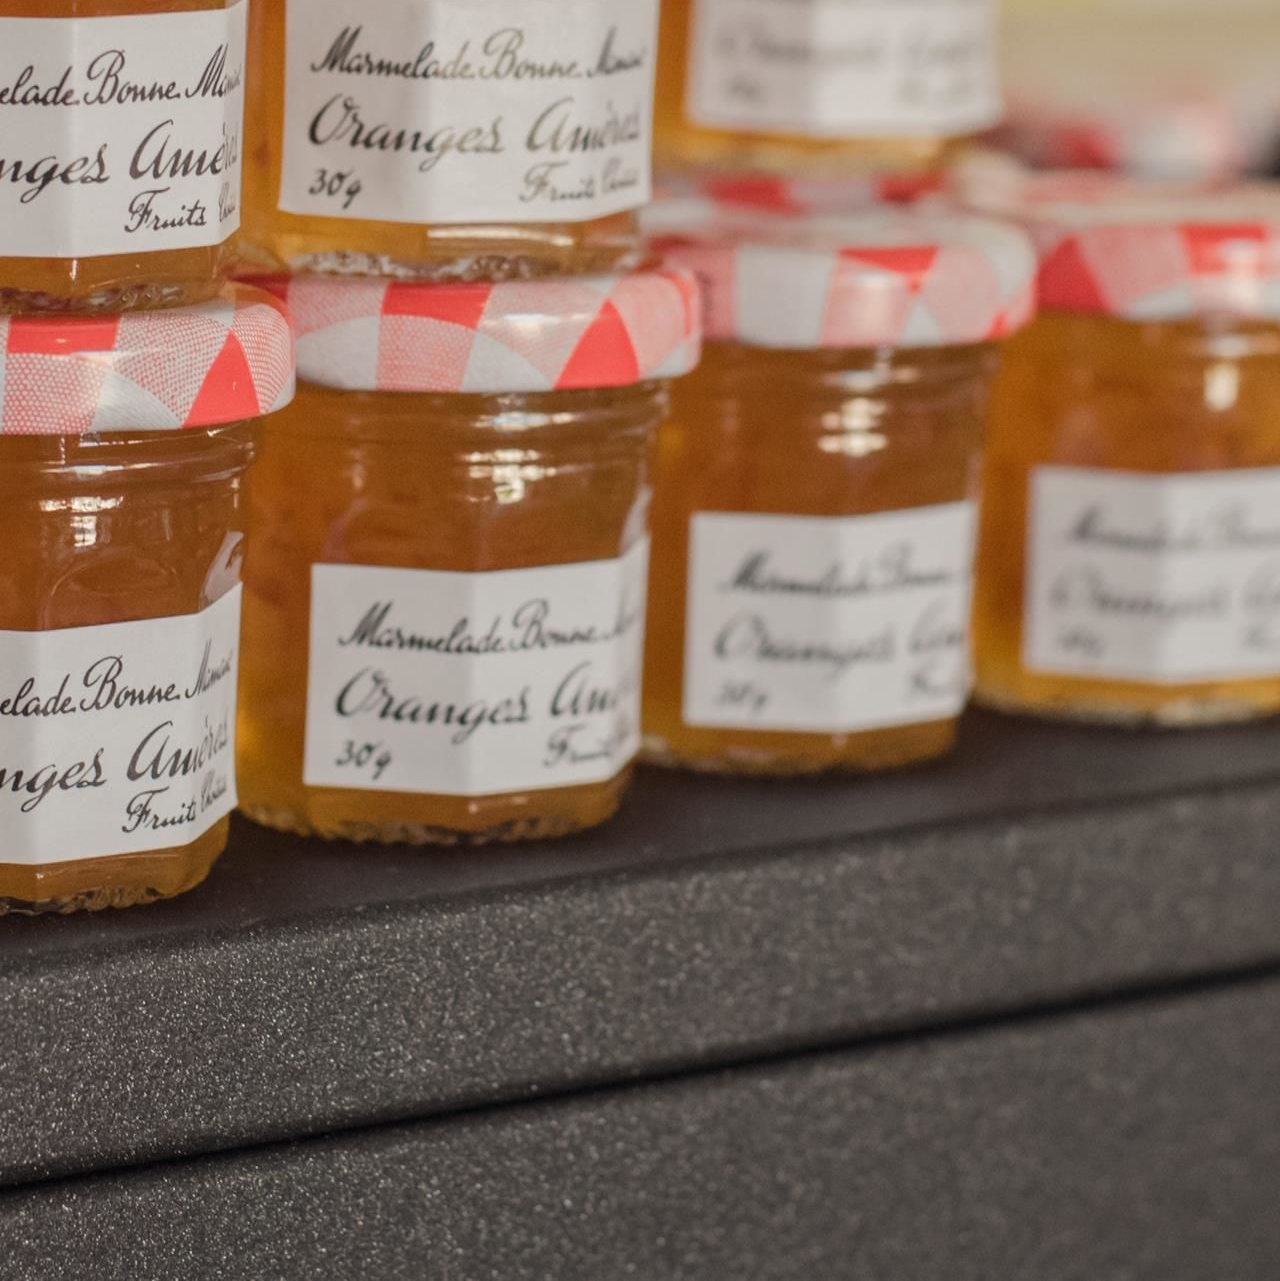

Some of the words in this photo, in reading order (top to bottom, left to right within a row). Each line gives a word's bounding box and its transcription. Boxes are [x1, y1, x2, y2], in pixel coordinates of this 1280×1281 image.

[83, 49, 181, 107] Bonne
[310, 24, 476, 80] Marmelade
[478, 27, 583, 81] Bonne
[308, 92, 505, 173] Oranges
[124, 186, 207, 234] Fruits
[308, 168, 363, 209] 30g
[337, 599, 508, 656] Marmelade
[80, 654, 182, 711] Bonne
[335, 665, 533, 746] Oranges
[335, 738, 393, 781] 30g
[121, 785, 198, 834] Fruits
